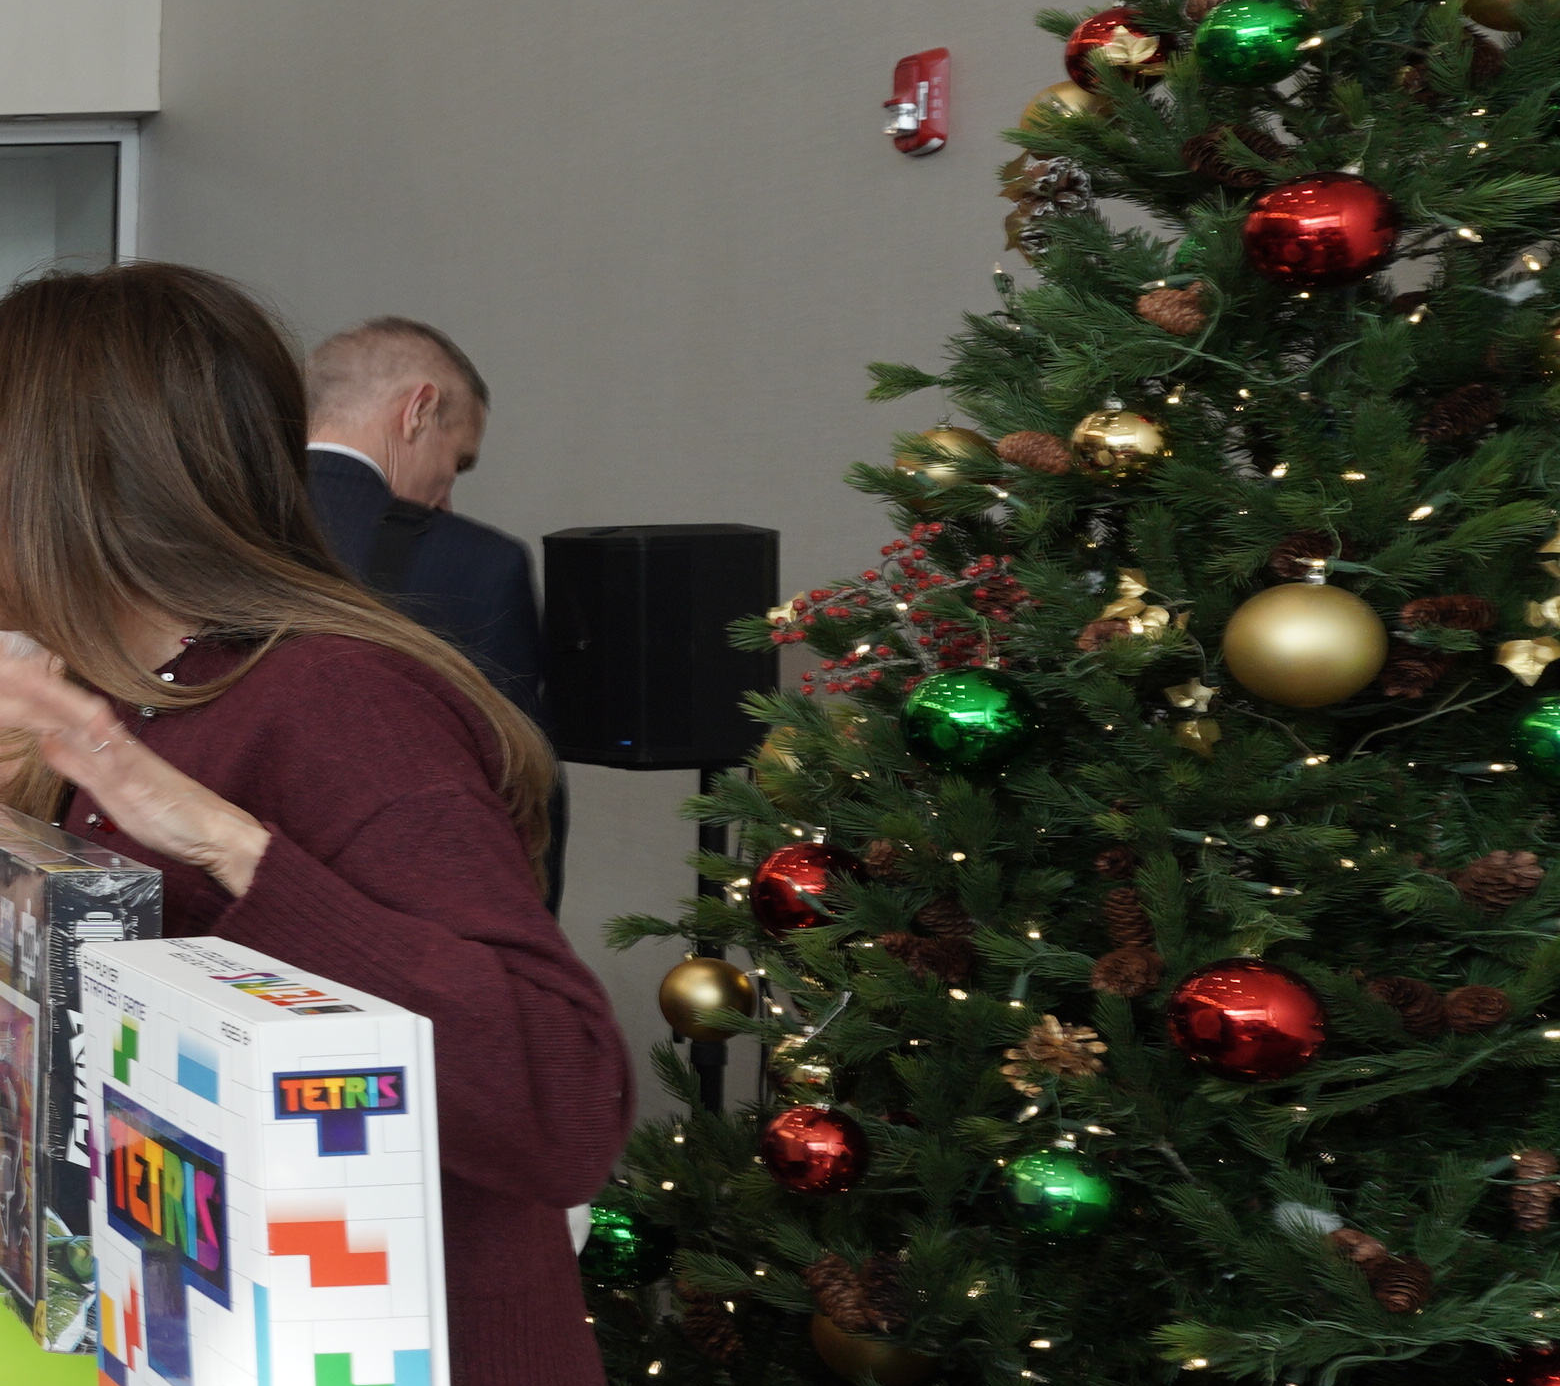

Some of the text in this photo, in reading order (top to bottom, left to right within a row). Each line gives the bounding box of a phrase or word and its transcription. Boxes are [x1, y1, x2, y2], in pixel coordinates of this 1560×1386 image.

[94, 959, 119, 984] PLAYER
[83, 976, 149, 1022] STRATEGY GAME
[221, 1021, 242, 1044] AGES
[280, 1075, 398, 1112] TETRIS
[107, 1114, 221, 1272] TETRIS
